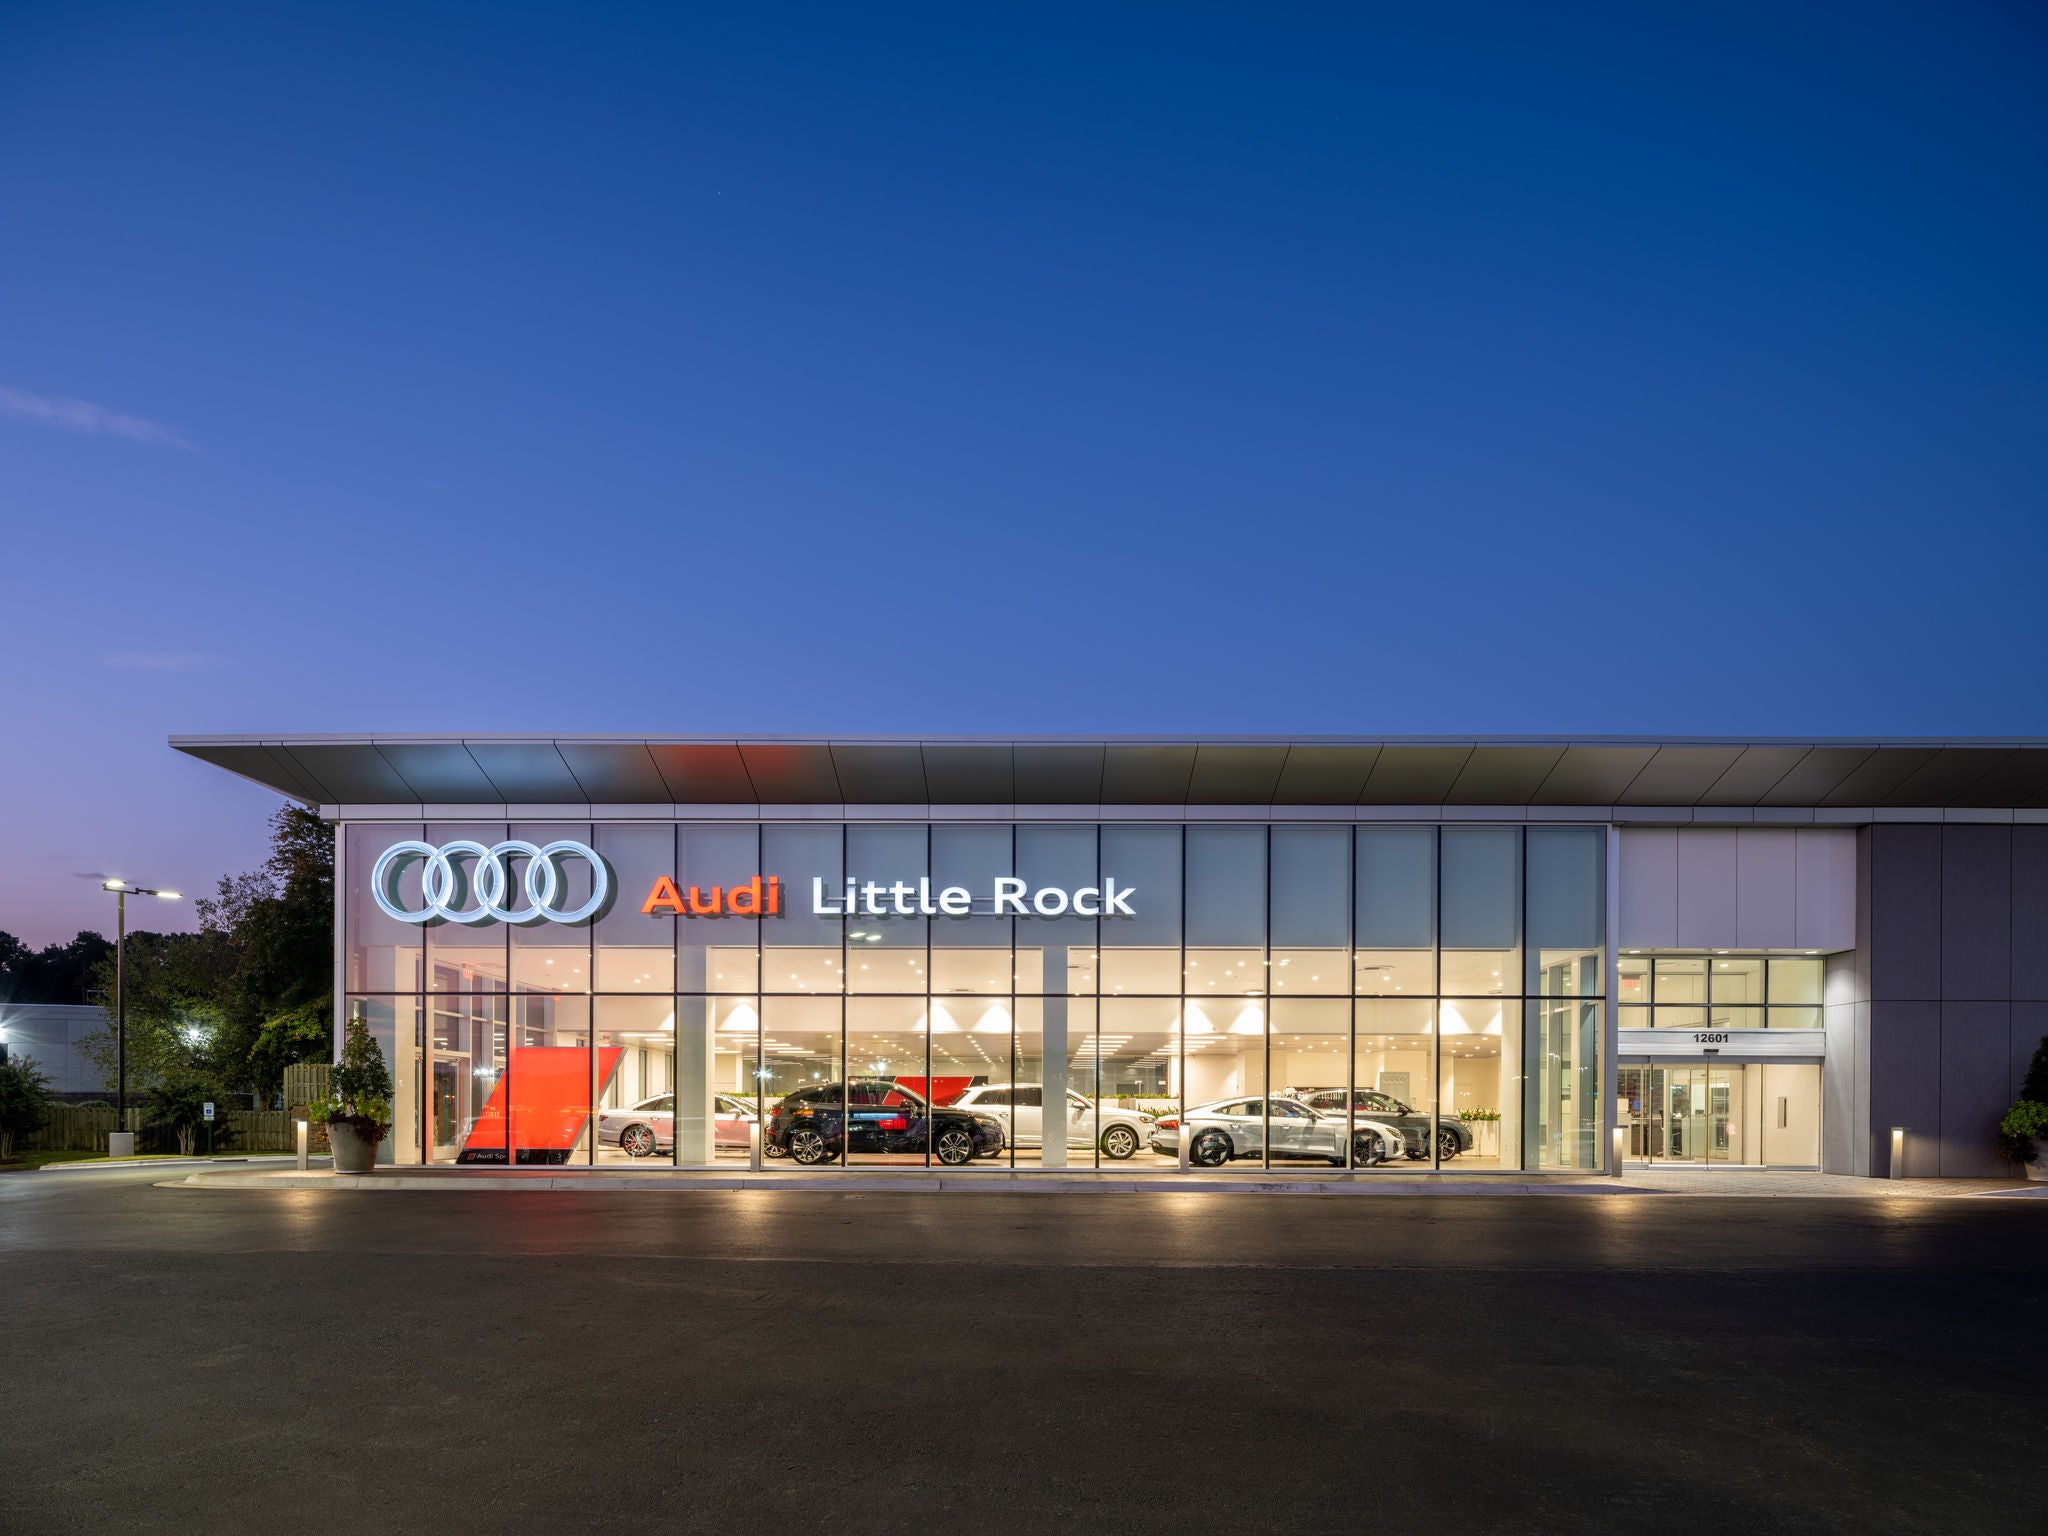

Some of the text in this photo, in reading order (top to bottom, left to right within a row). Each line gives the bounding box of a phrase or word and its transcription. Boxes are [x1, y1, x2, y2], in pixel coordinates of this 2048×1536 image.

[641, 875, 1137, 915] Audi Little Rock
[1693, 1033, 1728, 1043] 12601
